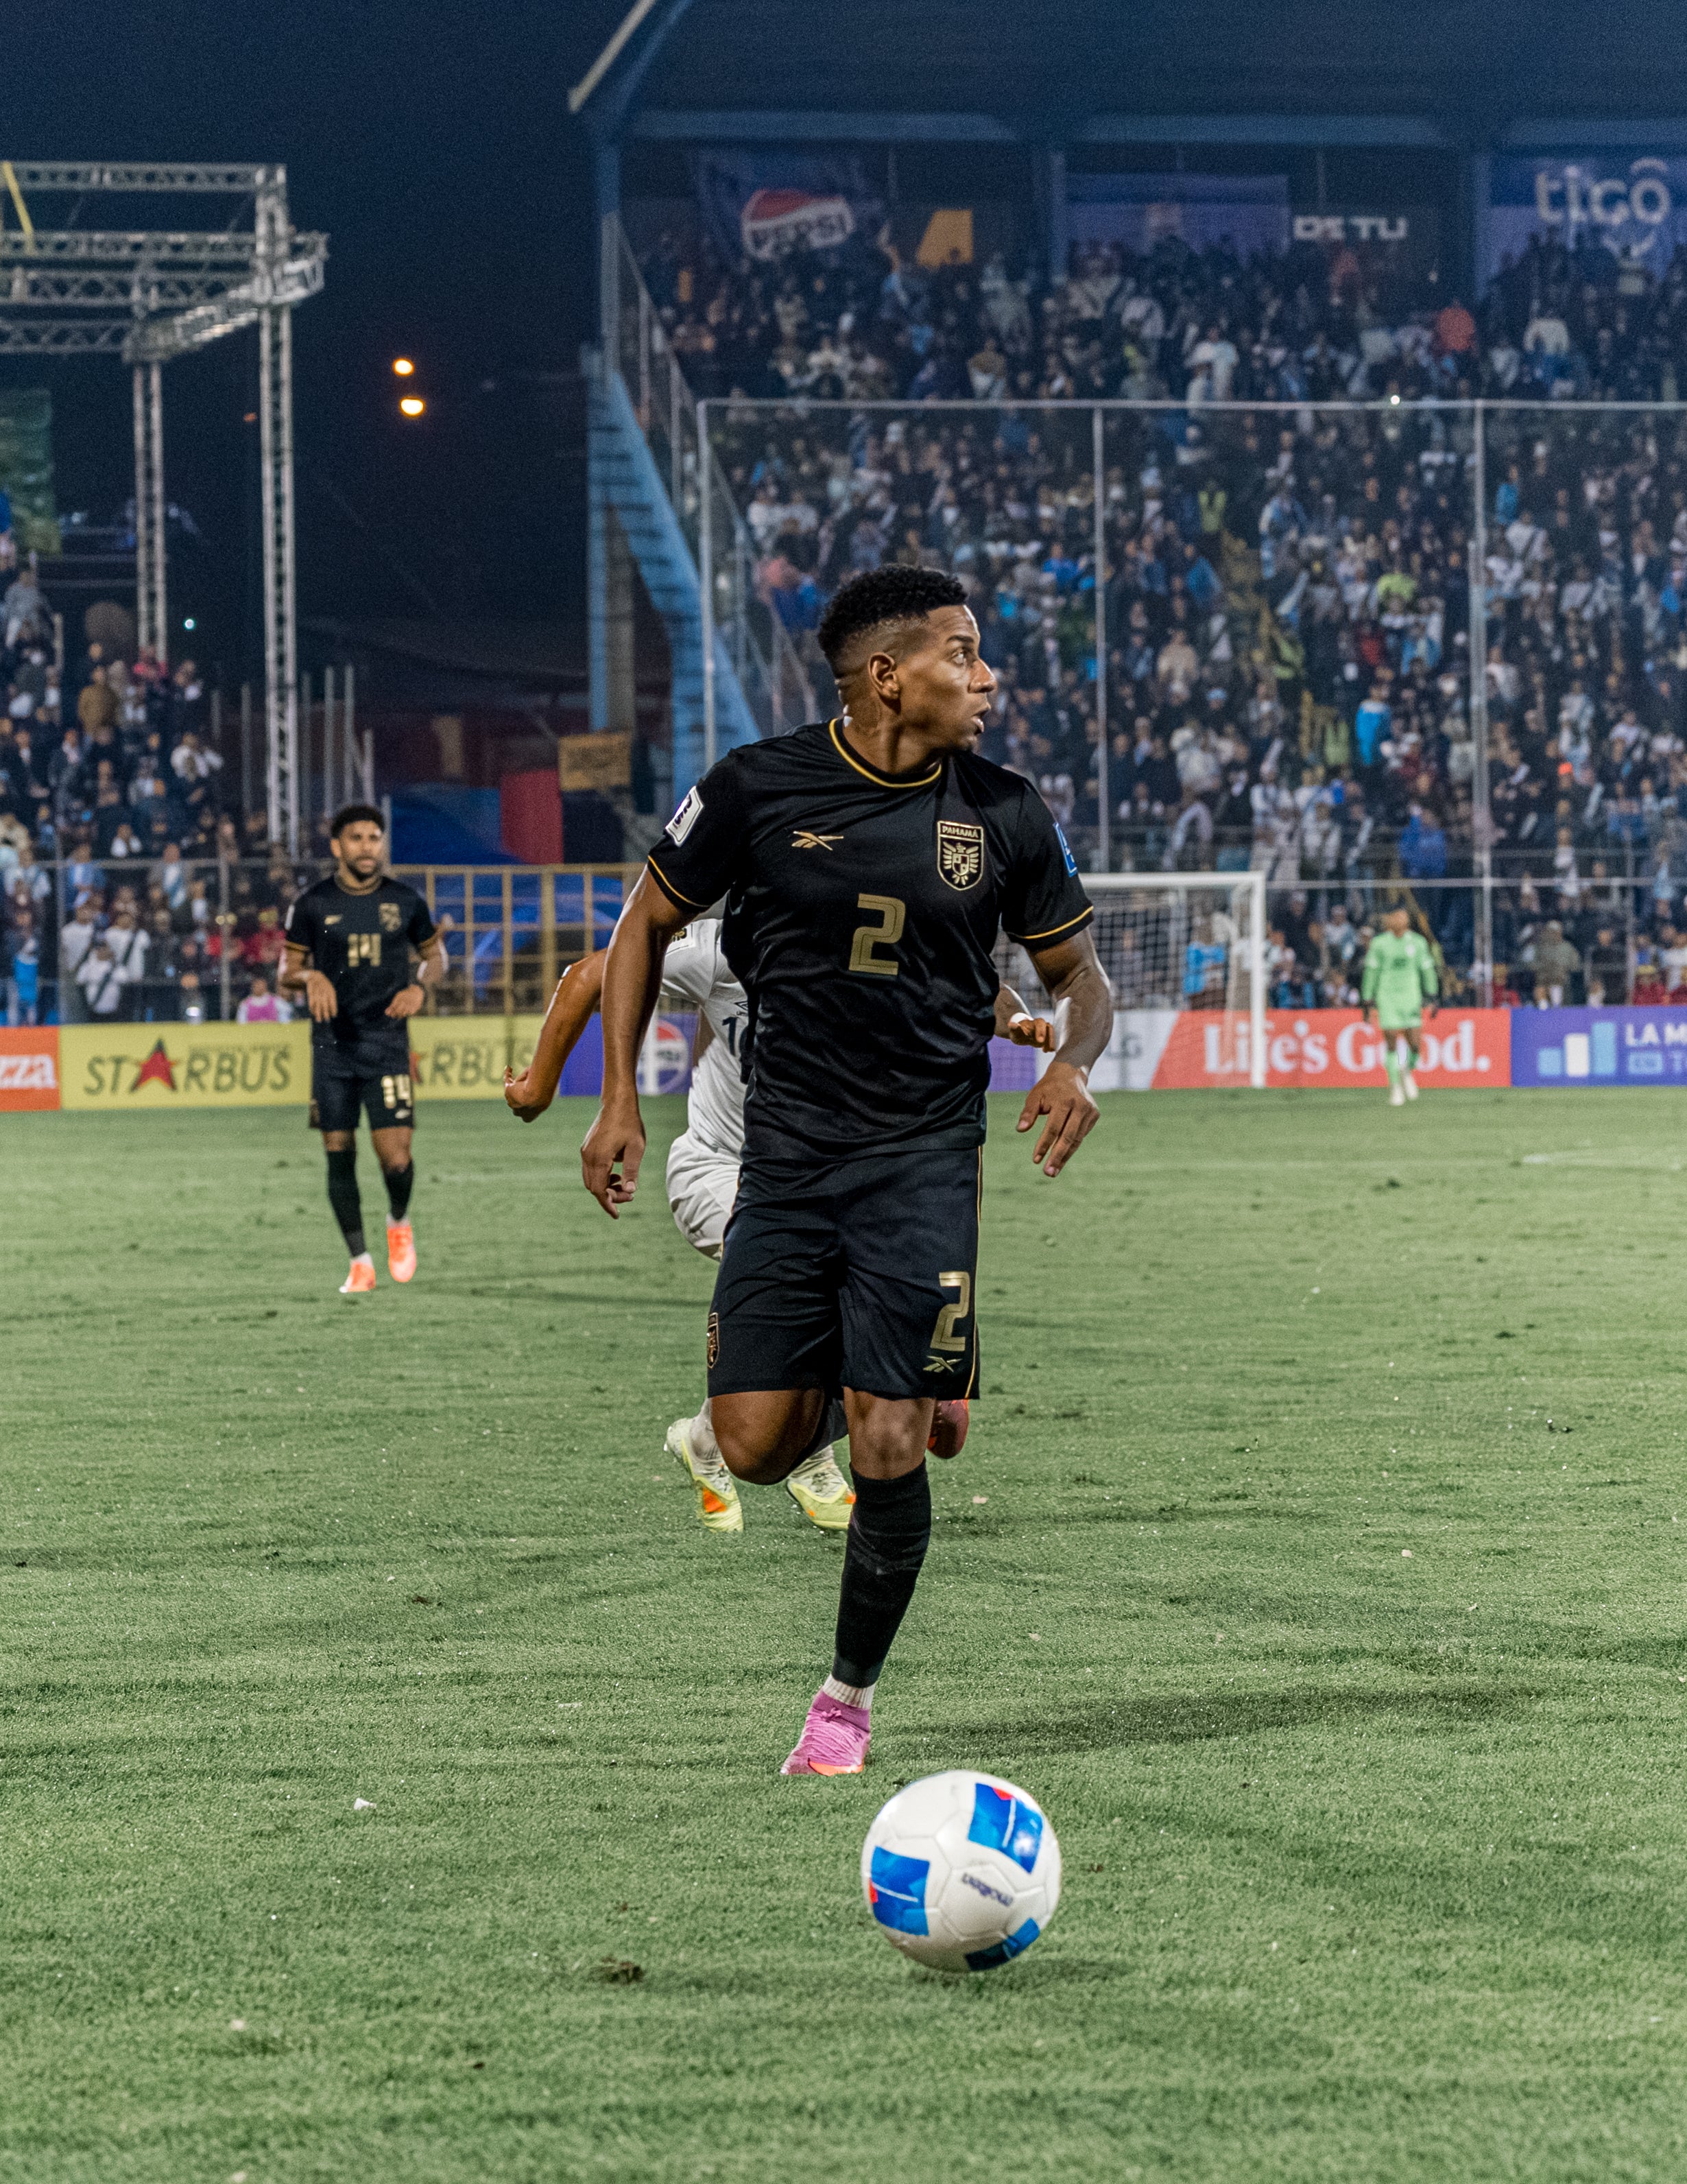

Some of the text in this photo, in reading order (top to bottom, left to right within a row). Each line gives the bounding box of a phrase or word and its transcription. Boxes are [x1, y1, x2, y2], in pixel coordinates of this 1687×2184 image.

[1350, 215, 1409, 241] TU
[348, 933, 381, 967] 14
[848, 893, 906, 976] 2
[1625, 1023, 1660, 1046] LA
[409, 1044, 535, 1086] RBUS
[929, 1271, 970, 1351] 2
